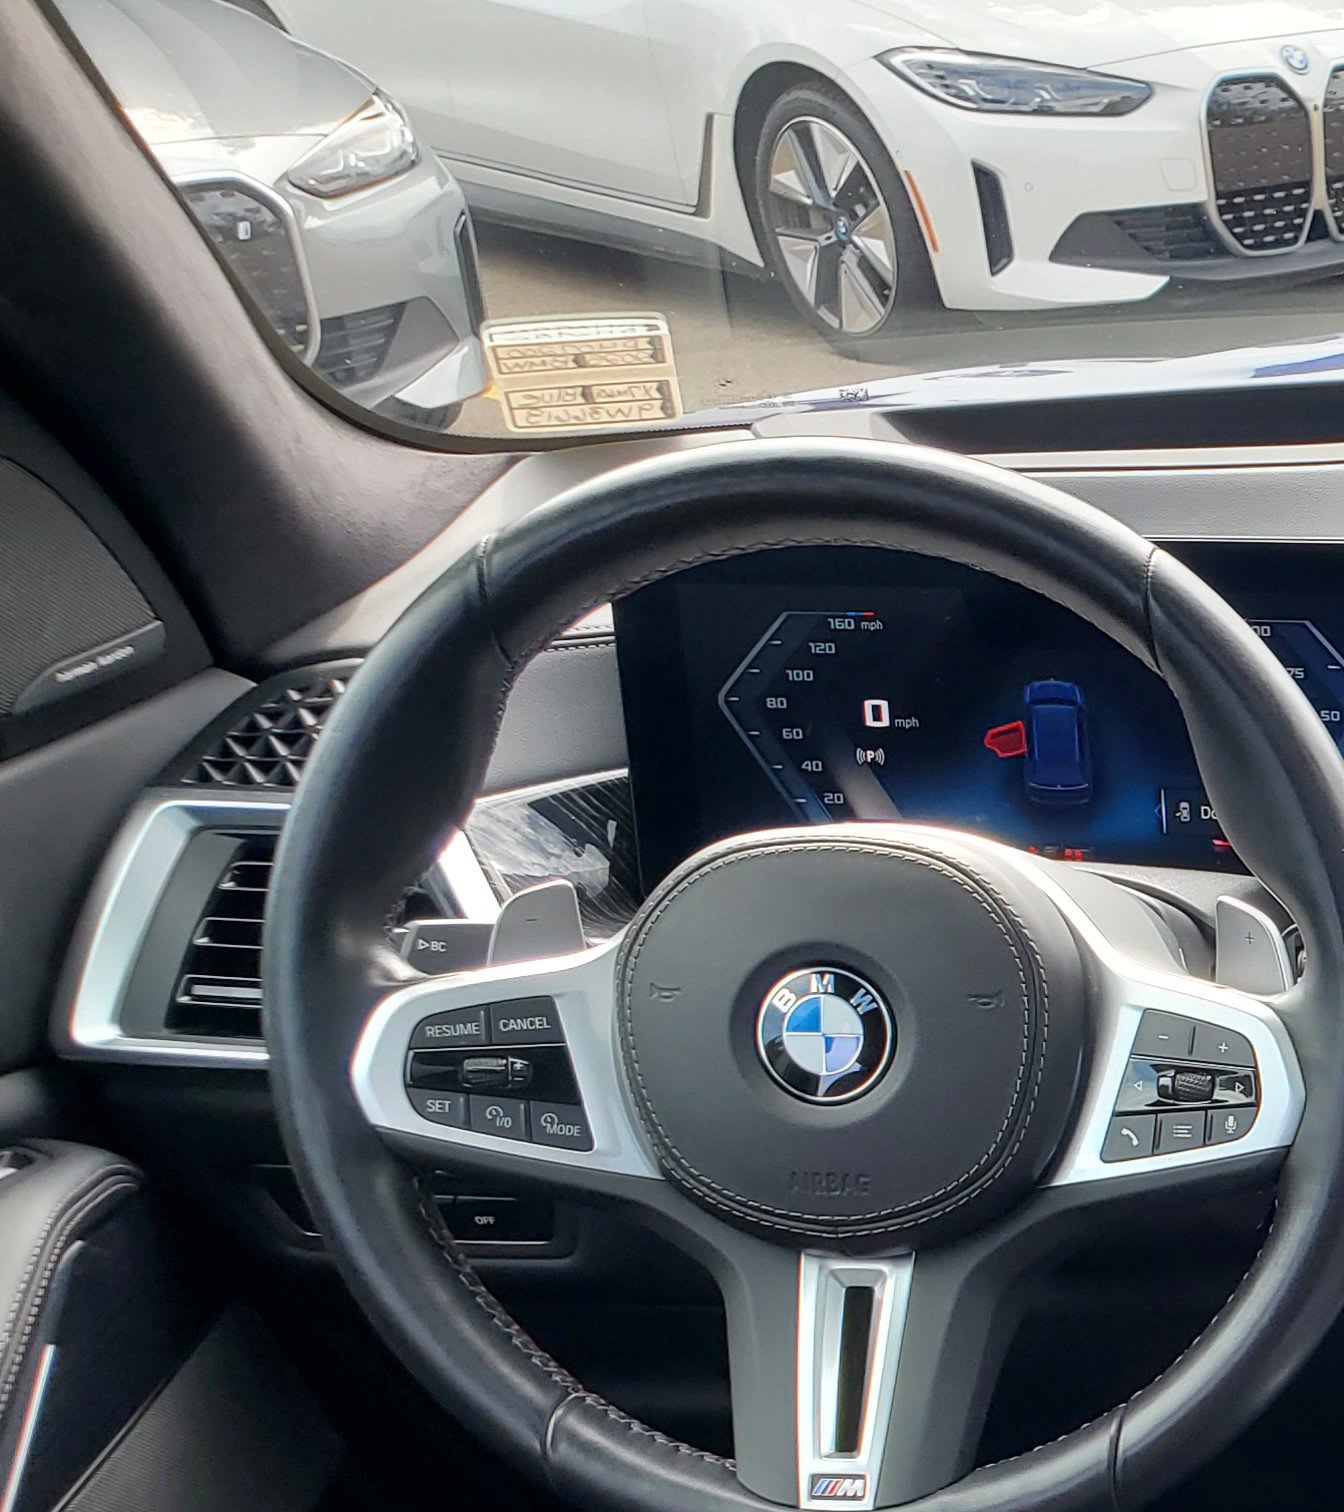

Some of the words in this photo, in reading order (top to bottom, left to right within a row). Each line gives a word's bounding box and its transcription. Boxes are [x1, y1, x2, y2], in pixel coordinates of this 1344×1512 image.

[827, 618, 855, 631] 160
[860, 620, 883, 632] mph
[808, 641, 836, 655] 120
[785, 669, 814, 682] 100
[766, 697, 788, 710] 80
[863, 699, 890, 728] 0
[894, 716, 919, 730] mph
[1320, 710, 1341, 722] 50
[781, 728, 803, 741] 60
[800, 760, 823, 773] 40
[823, 793, 844, 805] 20
[431, 940, 447, 953] BC
[773, 973, 880, 1016] BMW
[425, 1020, 481, 1038] RESUME
[499, 1015, 552, 1033] CANCEL
[426, 1100, 452, 1114] SET
[546, 1120, 582, 1137] MODE
[474, 1215, 496, 1226] OFF
